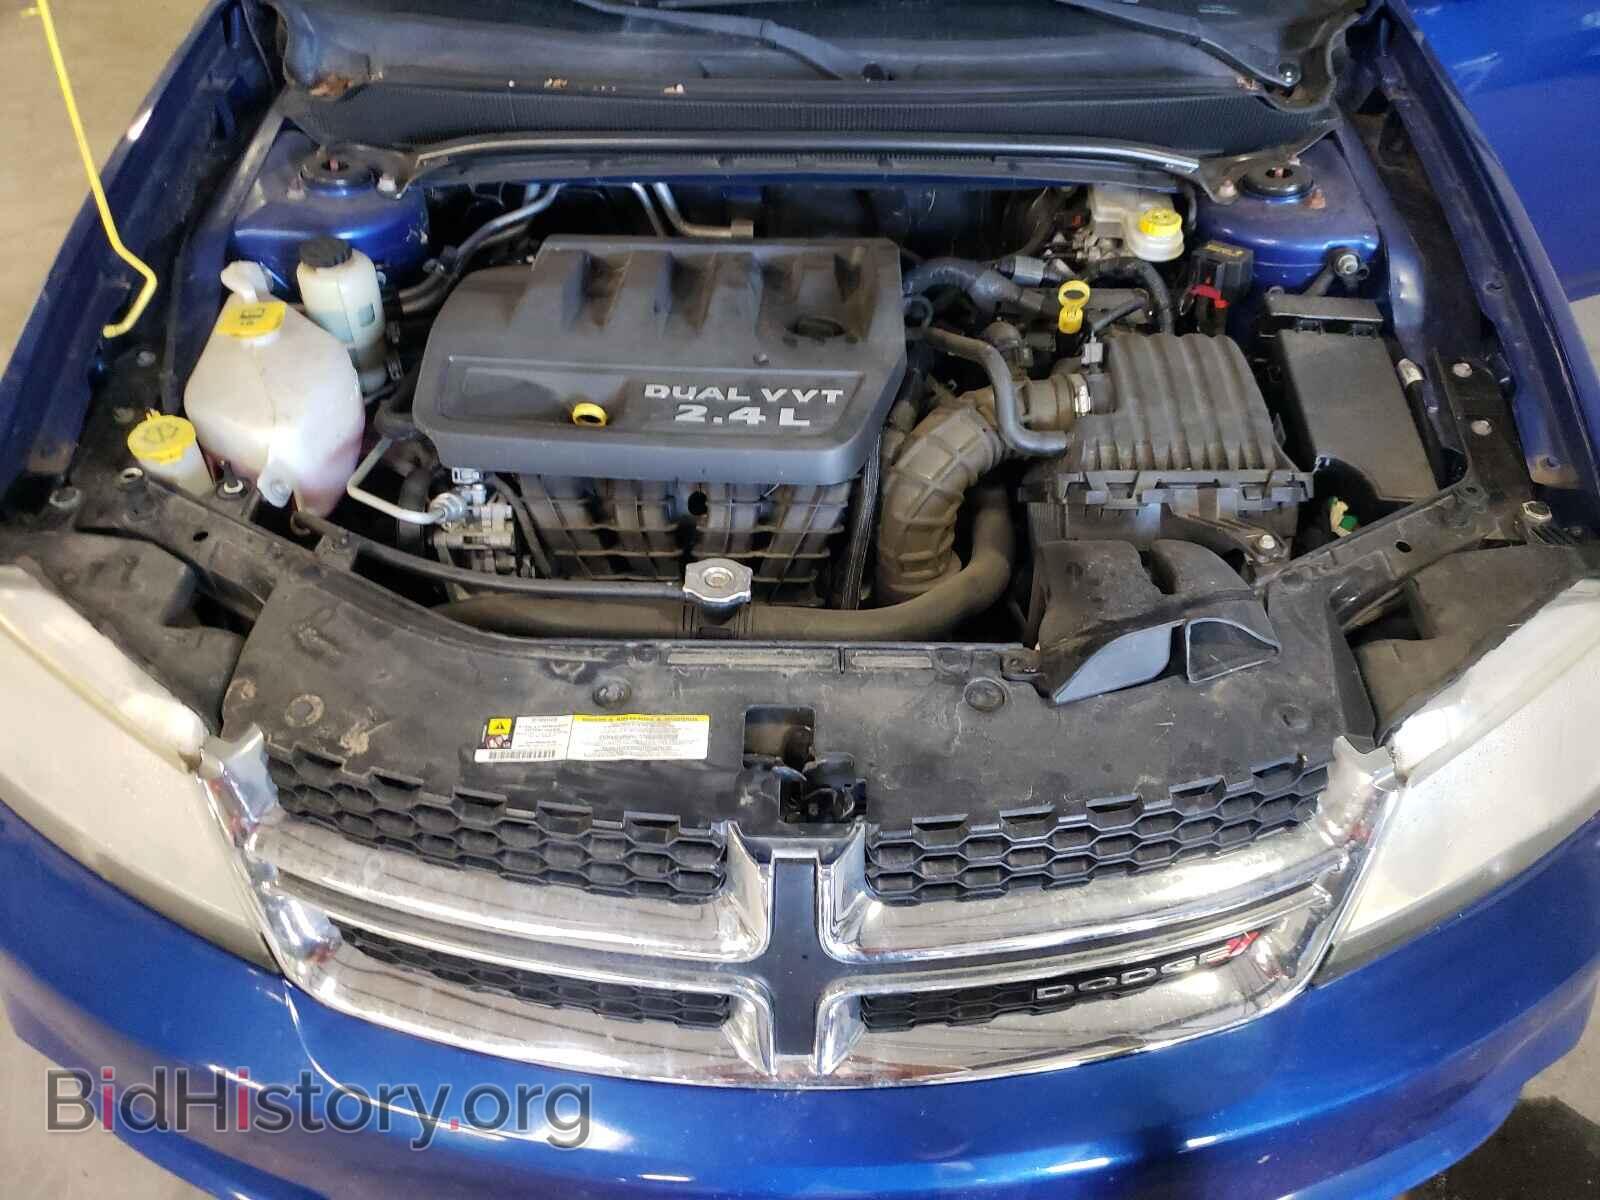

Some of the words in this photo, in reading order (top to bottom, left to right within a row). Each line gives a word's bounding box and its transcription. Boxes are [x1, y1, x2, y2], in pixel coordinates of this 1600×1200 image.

[644, 384, 750, 401] DUAL
[761, 388, 844, 404] VVT
[674, 404, 766, 425] 2.4
[779, 407, 811, 426] L
[1036, 946, 1234, 999] DODGE
